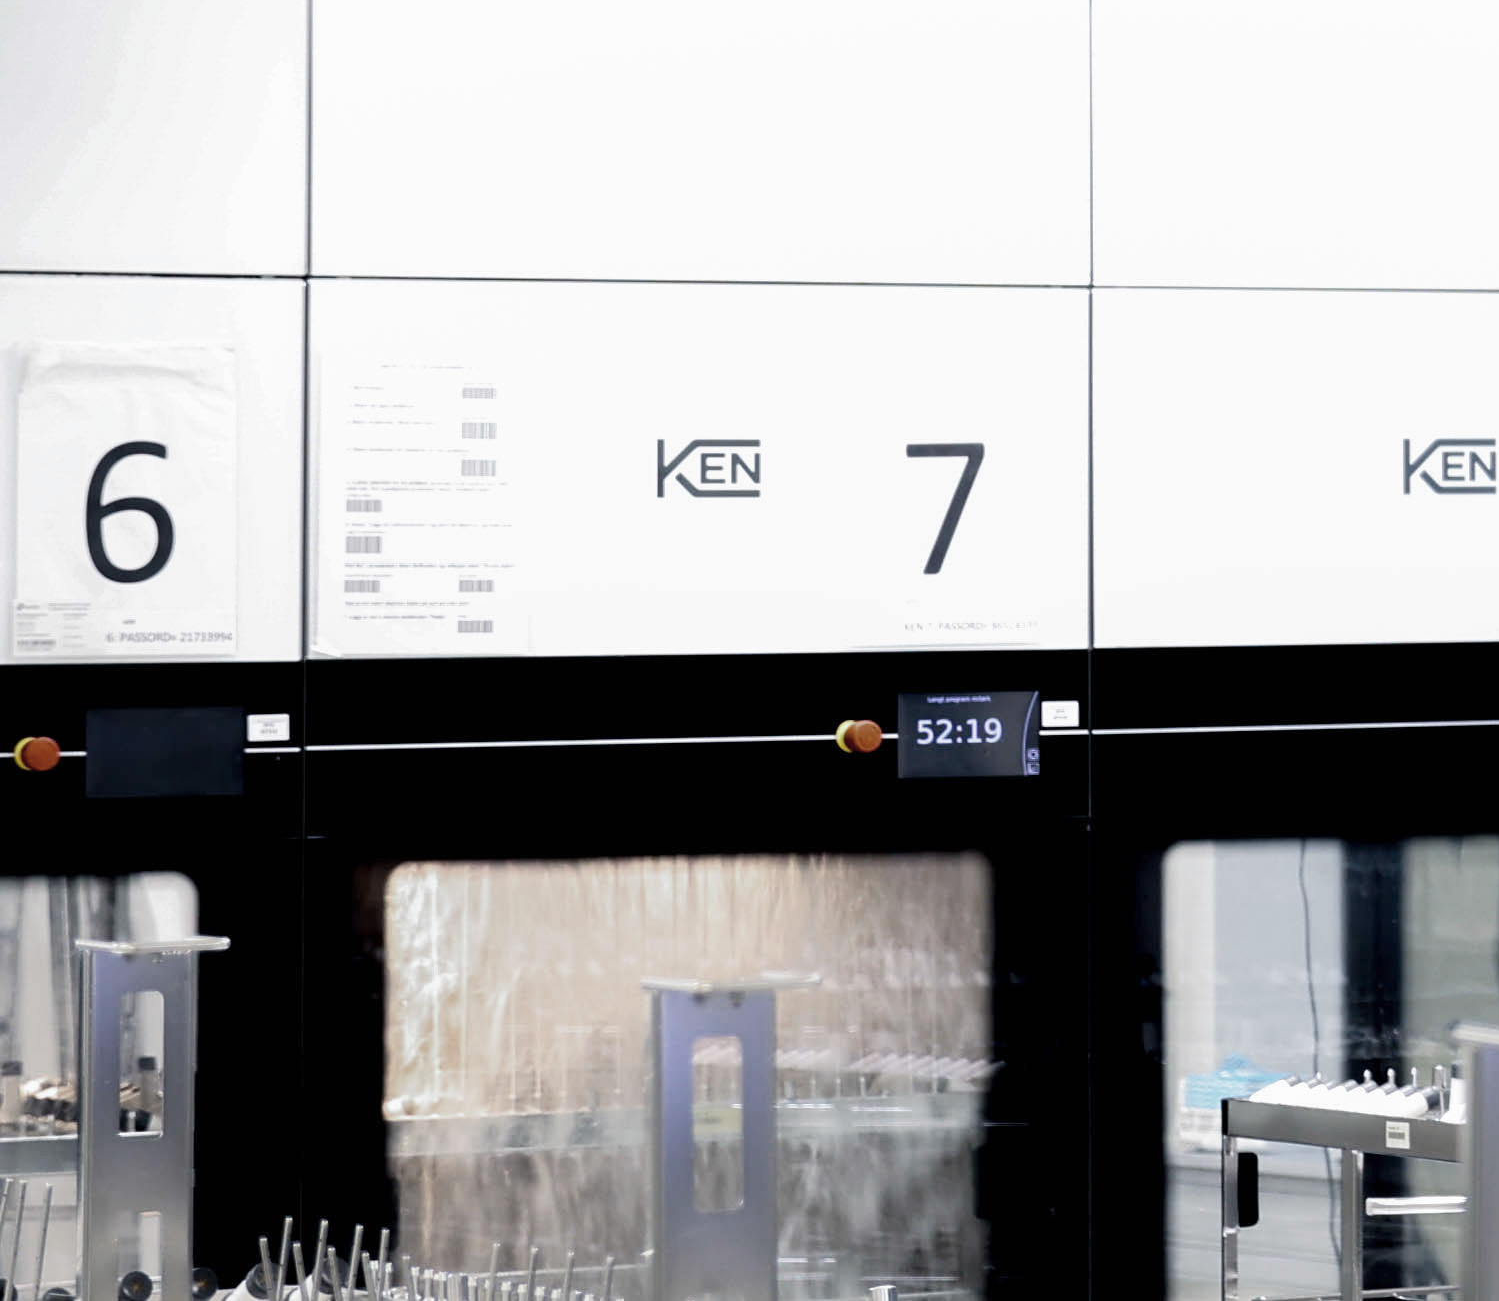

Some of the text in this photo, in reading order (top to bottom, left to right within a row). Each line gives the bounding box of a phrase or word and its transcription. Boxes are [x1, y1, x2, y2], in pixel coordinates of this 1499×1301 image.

[657, 439, 761, 498] KEN
[1403, 439, 1496, 494] KEN
[86, 441, 175, 583] 6
[906, 443, 985, 575] 7
[917, 717, 1002, 745] 52:19
